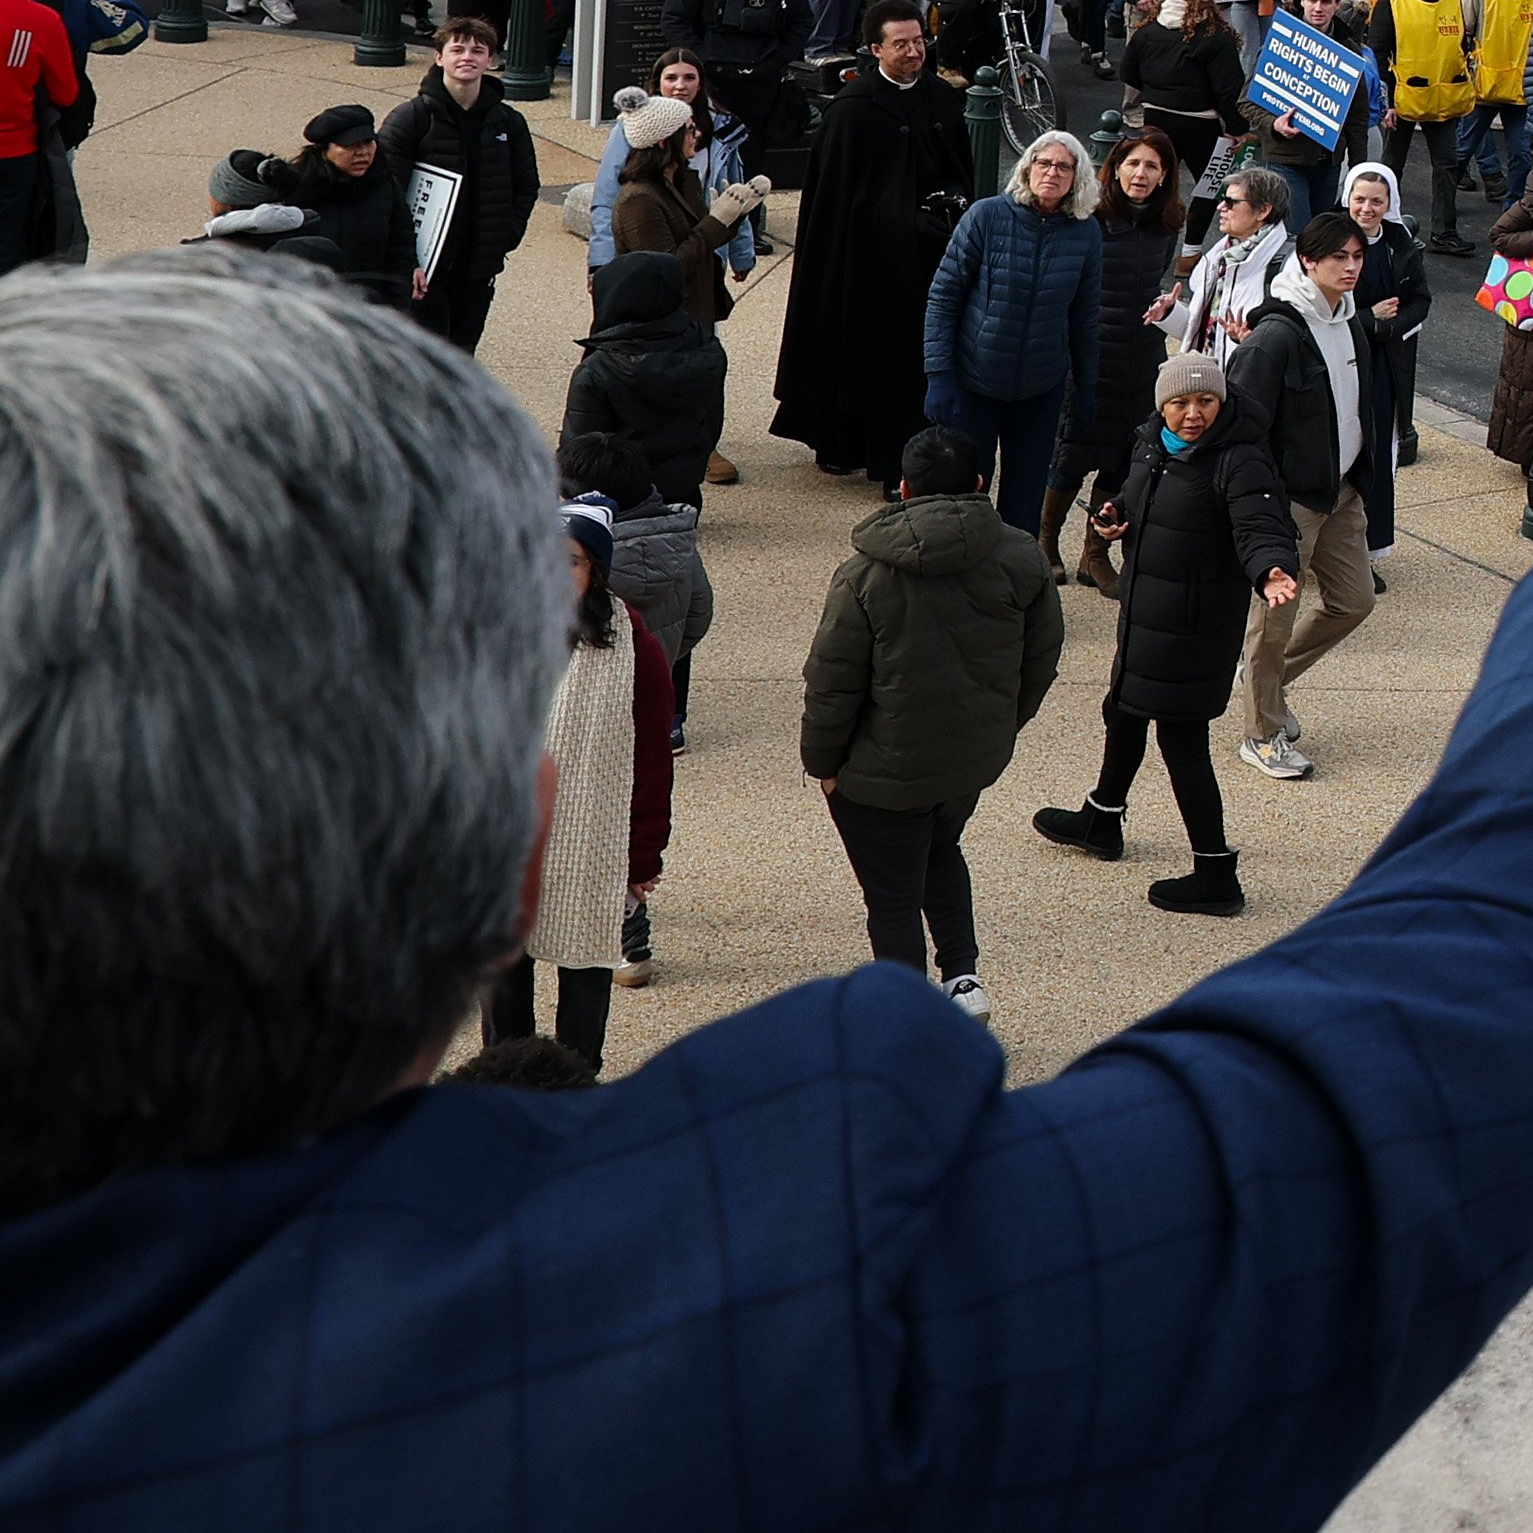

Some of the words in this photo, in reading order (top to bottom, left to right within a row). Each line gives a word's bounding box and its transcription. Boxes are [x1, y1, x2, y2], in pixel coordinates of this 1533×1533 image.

[1268, 38, 1314, 74] RIGHTS
[1314, 63, 1350, 97] BEGIN
[1292, 32, 1339, 69] HUMAN
[1264, 62, 1341, 118] CONCEPTION
[1202, 156, 1222, 181] LIFE
[1206, 146, 1234, 193] CHOOSE
[415, 179, 434, 229] FREE
